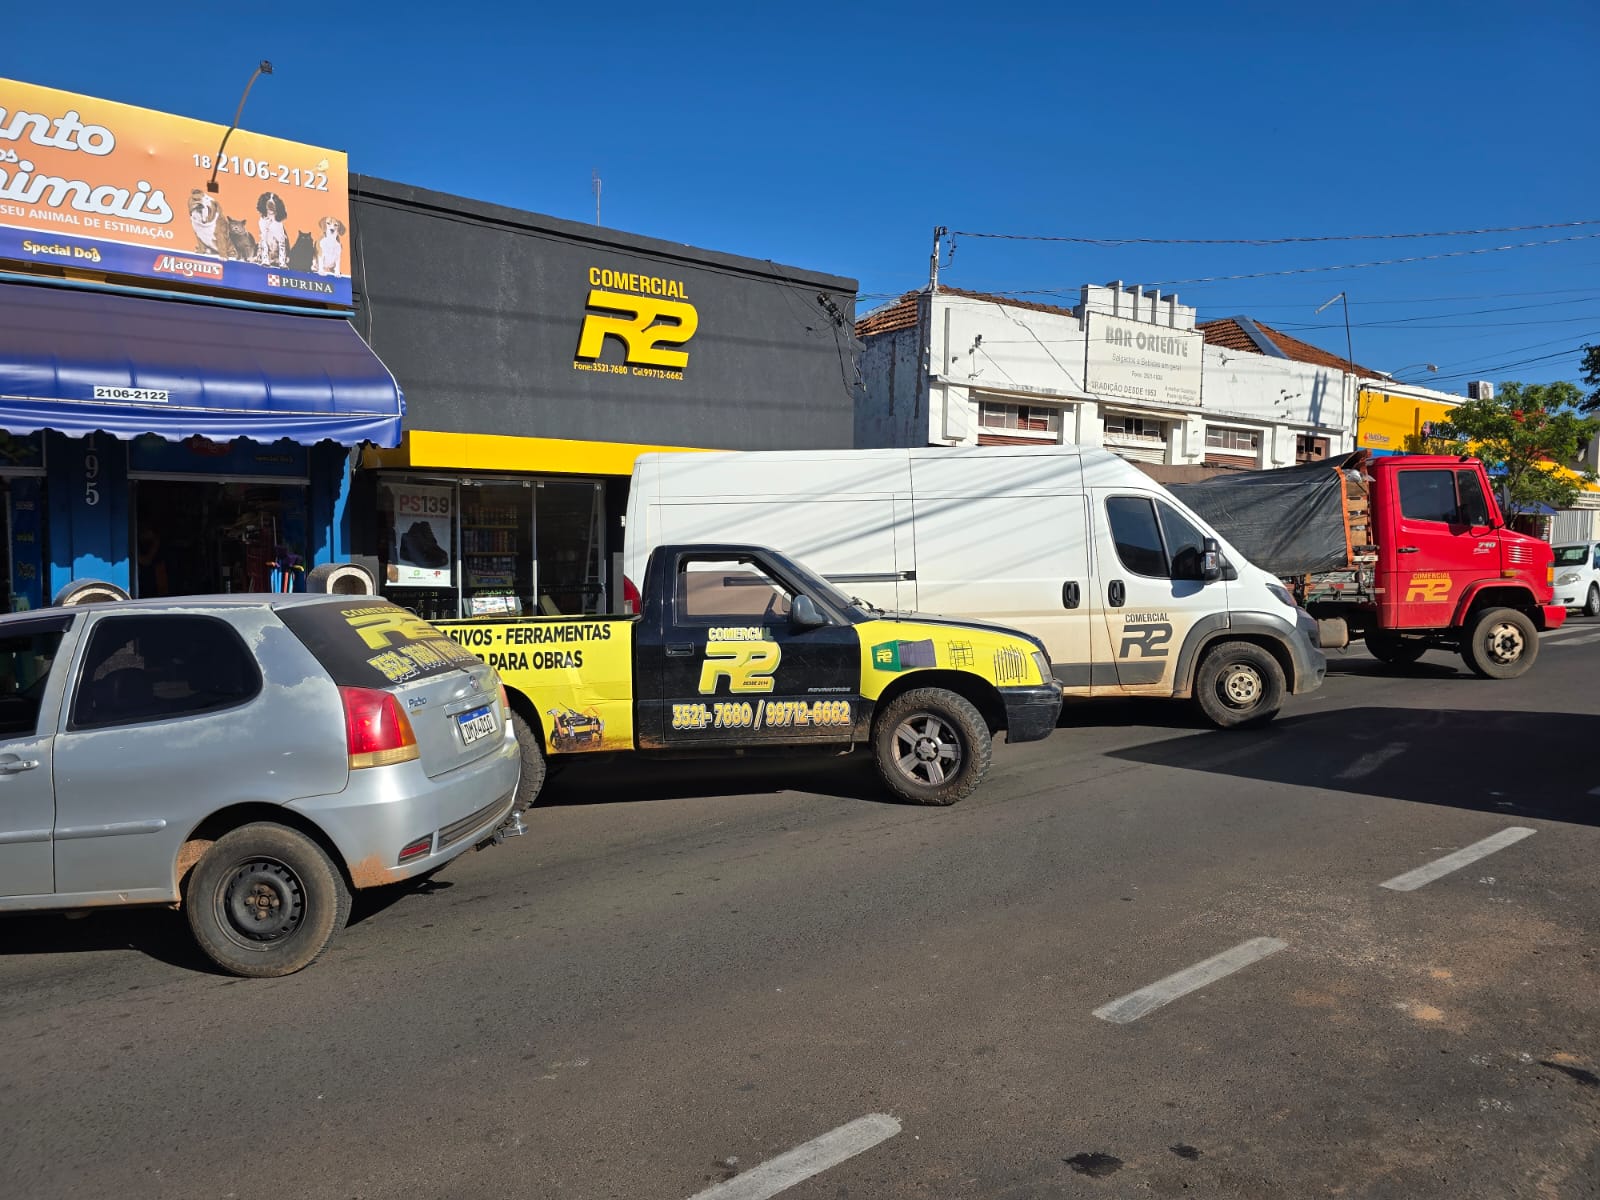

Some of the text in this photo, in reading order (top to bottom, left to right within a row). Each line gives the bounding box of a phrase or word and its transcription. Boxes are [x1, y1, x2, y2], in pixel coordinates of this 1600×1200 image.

[193, 152, 329, 192] 18 2106-2122
[0, 205, 174, 240] SEU ANIMAL DE ESTIMAÇÃO
[23, 241, 101, 262] Special Dog
[153, 256, 221, 277] Magnus
[282, 278, 333, 294] PURINA
[588, 267, 689, 299] COMERCIAL
[577, 289, 699, 368] R2
[1105, 325, 1188, 358] BAR ORIENTE
[96, 388, 167, 400] 2106-2122
[1091, 380, 1123, 393] TRADIÇÃO
[1123, 385, 1144, 396] DESDE
[400, 495, 449, 513] PS139
[1412, 572, 1451, 580] COMERCIAL
[1405, 579, 1452, 602] R2
[1125, 612, 1169, 622] COMERCIAL
[505, 624, 611, 645] FERRAMENTAS
[708, 627, 774, 641] COMERCIAL
[1119, 623, 1173, 658] R2
[489, 651, 529, 671] PARA
[533, 650, 583, 669] OBRAS
[698, 640, 782, 694] R2
[766, 701, 850, 727] 99712-6662
